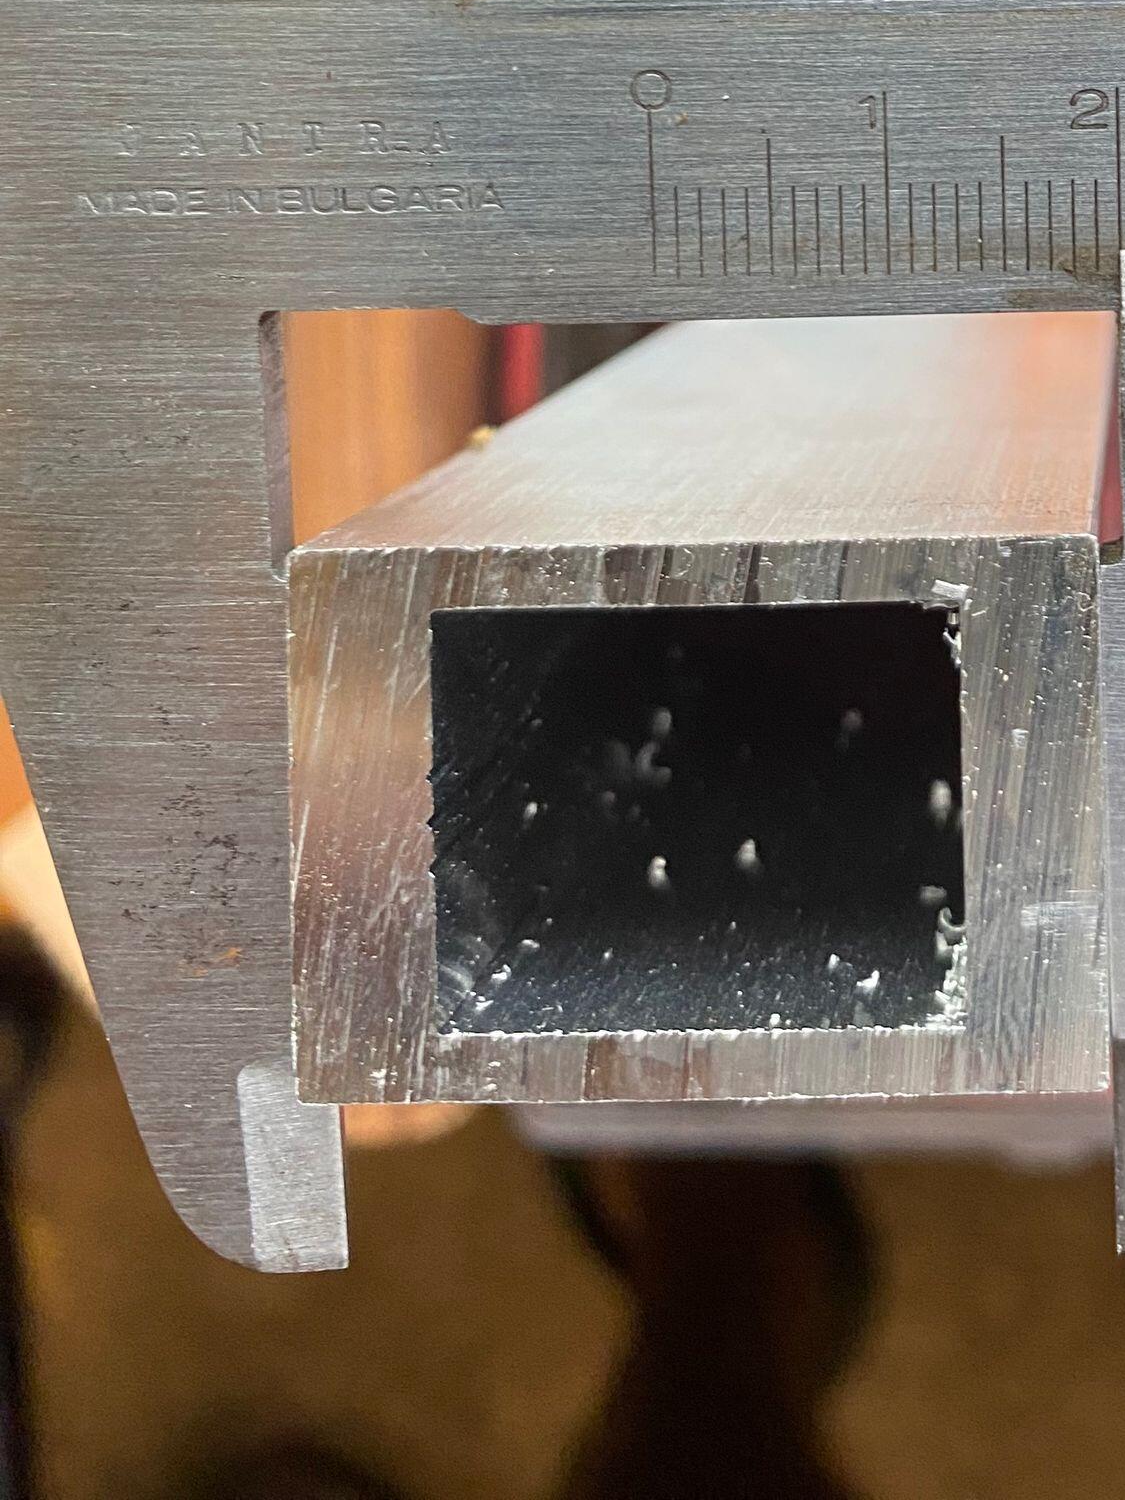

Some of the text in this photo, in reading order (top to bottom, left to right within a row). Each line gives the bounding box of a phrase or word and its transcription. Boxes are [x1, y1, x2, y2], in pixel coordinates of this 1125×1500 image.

[858, 94, 877, 129] 1
[1069, 88, 1109, 130] 2
[76, 182, 505, 216] MADE IN BULGARIA
